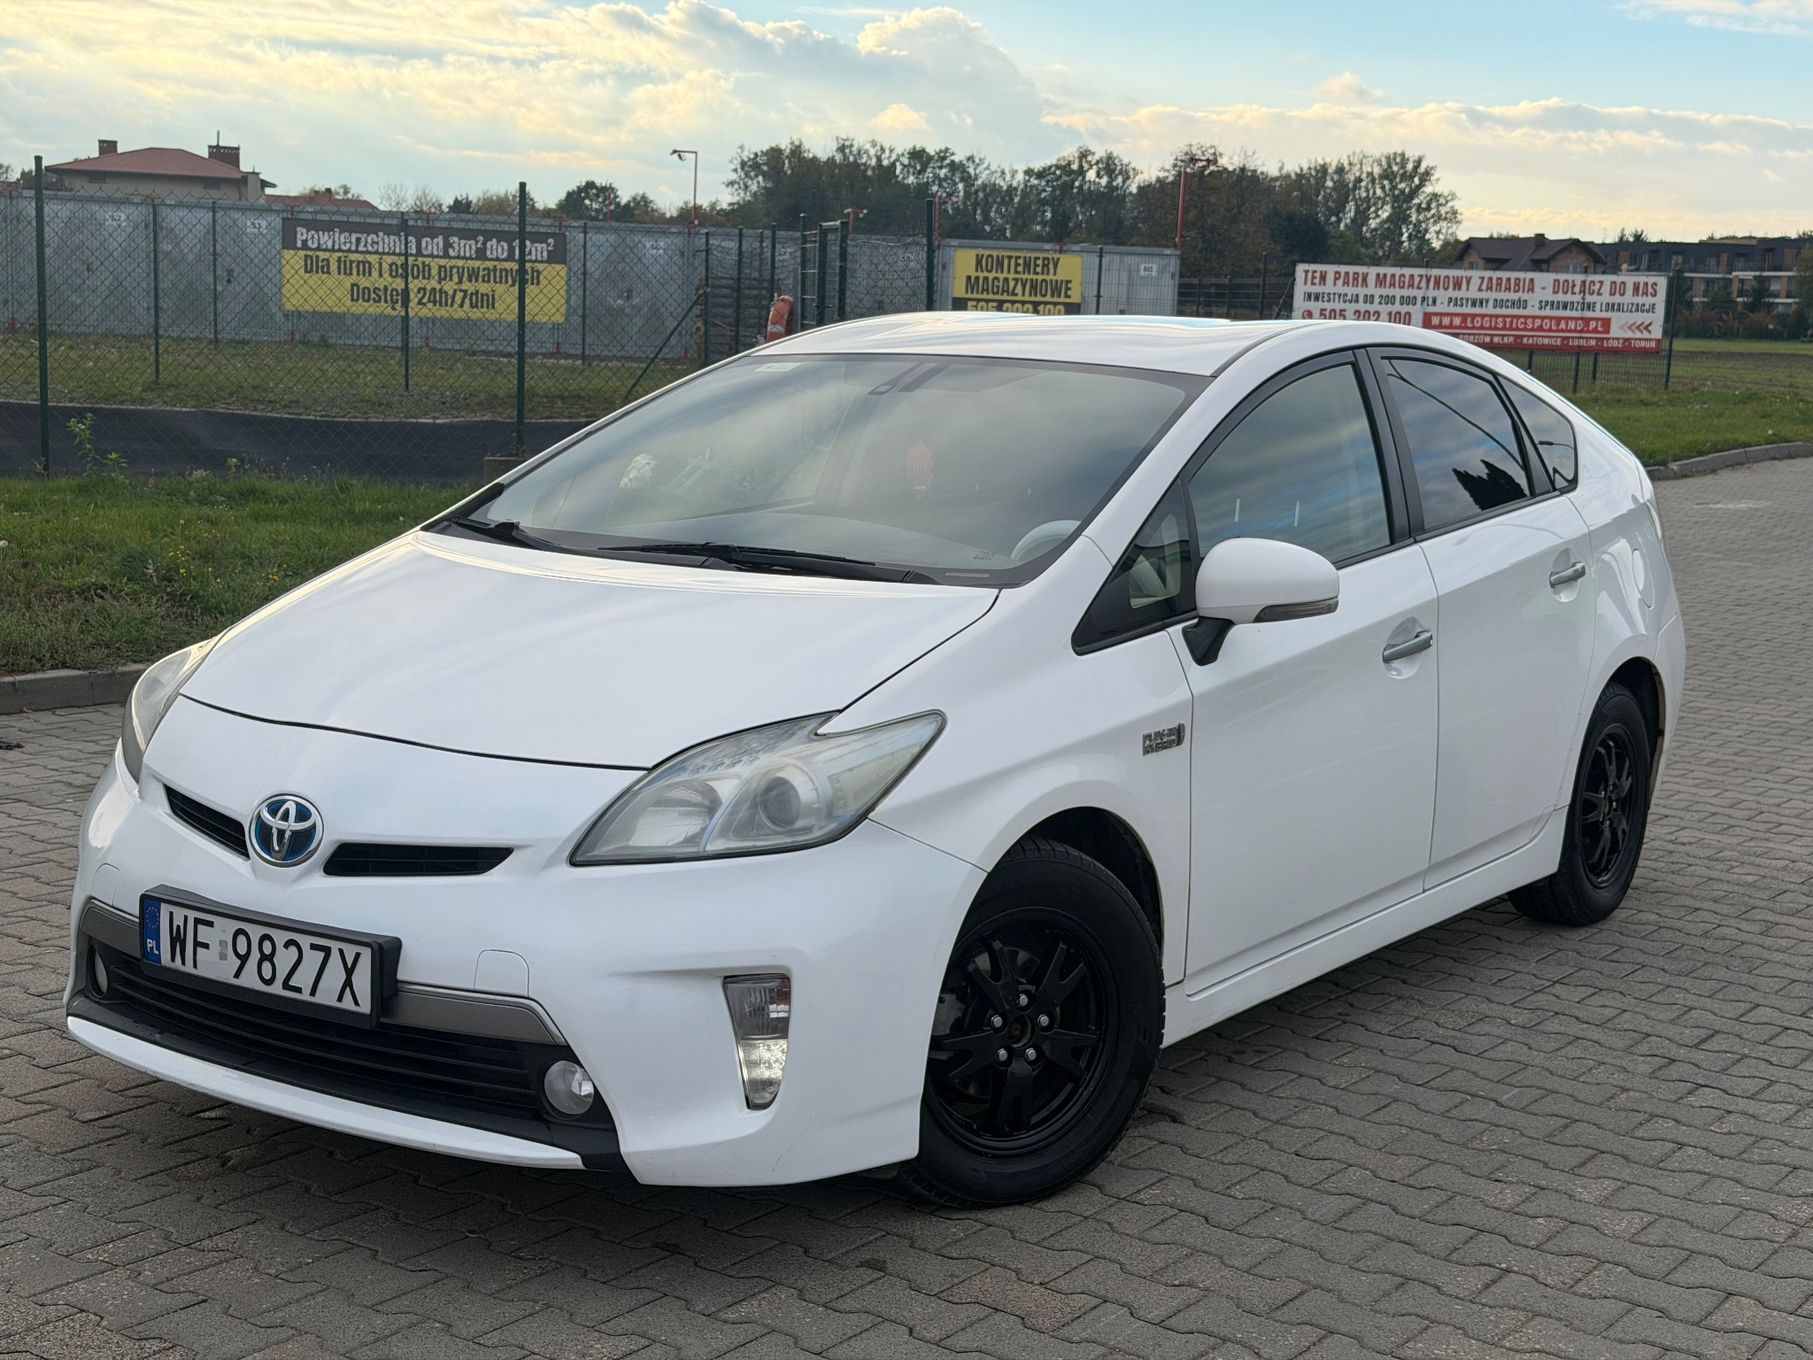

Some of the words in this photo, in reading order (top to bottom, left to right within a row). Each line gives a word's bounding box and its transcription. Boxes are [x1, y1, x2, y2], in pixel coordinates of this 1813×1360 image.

[296, 226, 417, 254] Powierzchnia
[421, 235, 444, 256] od
[486, 238, 508, 259] do
[304, 254, 332, 275] Dla
[337, 255, 372, 277] firm
[379, 257, 384, 278] i
[389, 257, 432, 280] osób
[975, 253, 1060, 276] KONTENERY
[965, 275, 1073, 299] MAGAZYNOWE
[1303, 269, 1328, 287] TEN
[1333, 271, 1369, 289] PARK
[1374, 272, 1472, 292] MAGAZYNOWY
[1477, 275, 1536, 294] ZARABIA
[1552, 278, 1604, 299] DOŁĄCZ
[1609, 281, 1627, 297] DO
[1632, 281, 1659, 298] NAS
[350, 282, 410, 311] Dostę
[416, 286, 497, 310] 24h/7dni
[1303, 291, 1360, 305] INWESTYCJA
[1363, 294, 1376, 305] OD
[1378, 295, 1396, 306] 200
[1400, 296, 1418, 307] 000
[1421, 296, 1438, 307] PLN
[1447, 297, 1490, 309] PASYWNY
[1493, 297, 1528, 310] DOCHÓD
[1538, 300, 1597, 312] SPRAWDZONE
[1600, 302, 1657, 314] LOKALIZACJE
[1387, 311, 1413, 326] 100
[1431, 315, 1604, 332] WWW.LOGISTICSPOLAND.PL
[1523, 336, 1562, 346] KATOWICE
[146, 938, 160, 955] PL
[169, 911, 214, 970] WF
[231, 927, 362, 1007] 9827X
